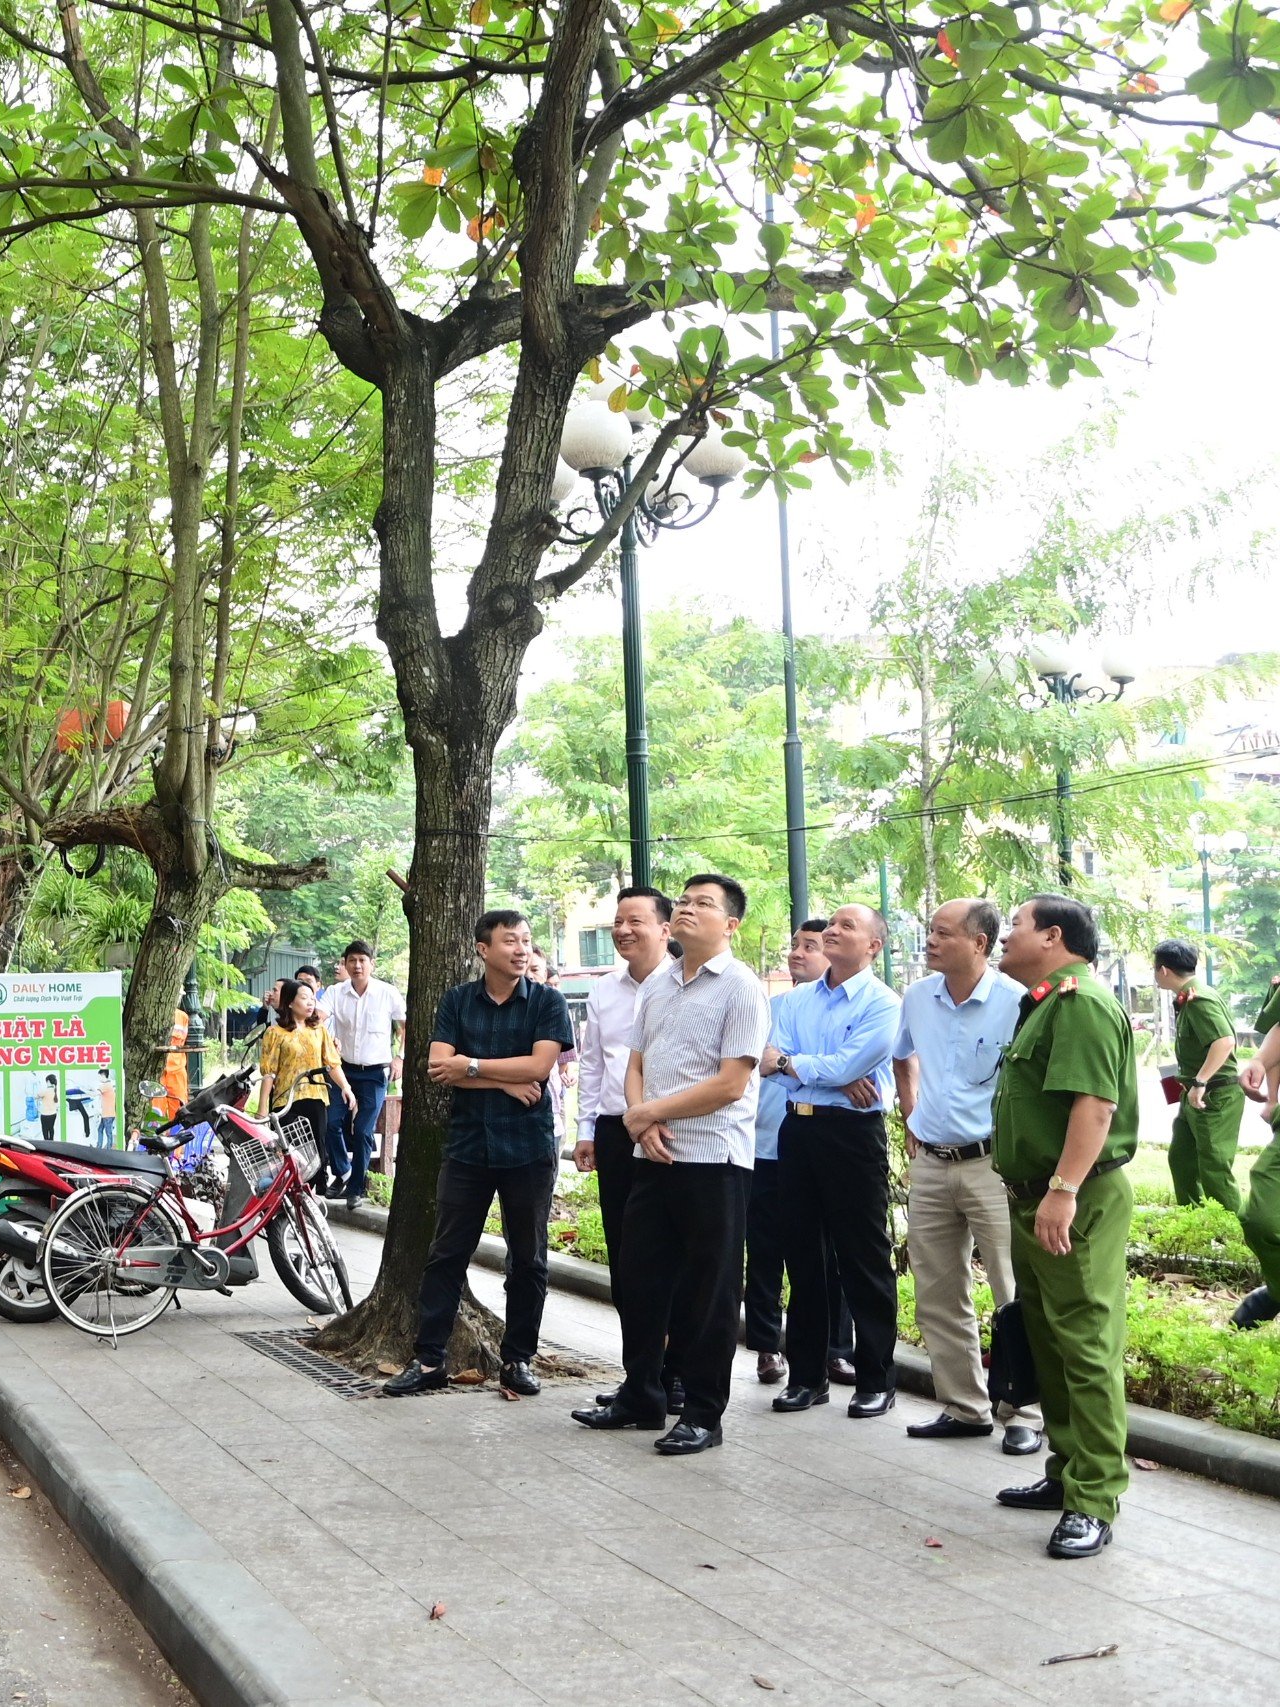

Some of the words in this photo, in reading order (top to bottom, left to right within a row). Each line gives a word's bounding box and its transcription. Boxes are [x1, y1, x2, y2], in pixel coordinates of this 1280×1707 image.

[12, 983, 46, 993] DAILY
[48, 983, 82, 993] HOME
[53, 1015, 85, 1038] LÀ
[39, 1042, 111, 1067] NGHỆ
